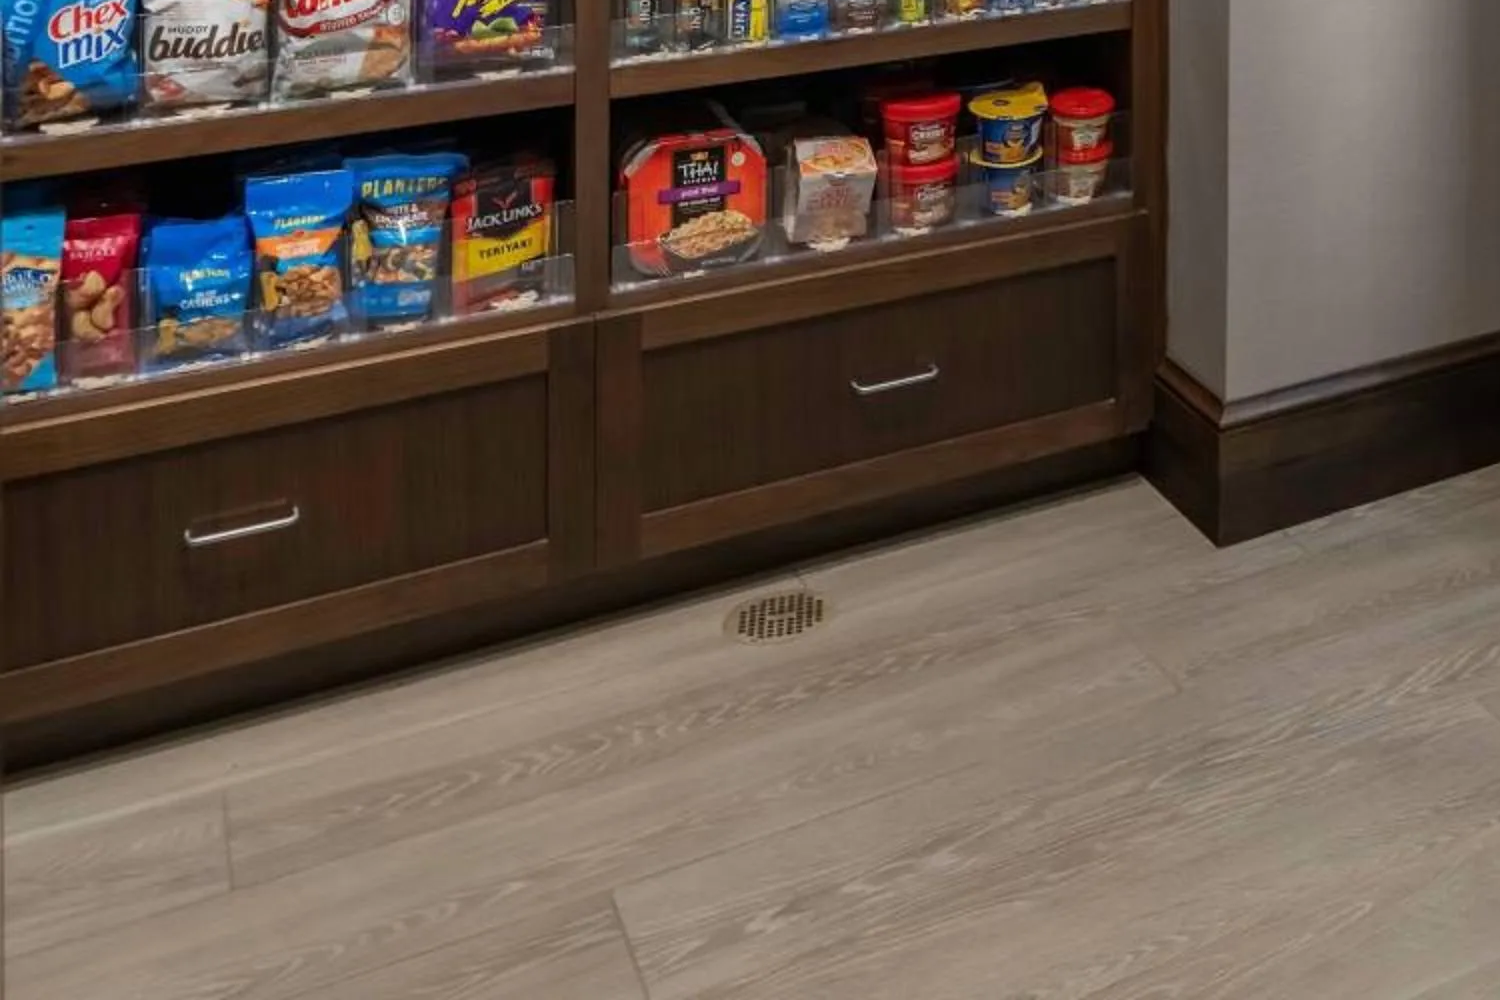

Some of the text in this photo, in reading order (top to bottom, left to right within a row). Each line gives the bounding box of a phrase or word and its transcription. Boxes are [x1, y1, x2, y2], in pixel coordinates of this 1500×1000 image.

[59, 24, 126, 69] mix
[678, 163, 720, 180] THAI
[360, 177, 450, 198] PLANTERS
[466, 203, 543, 232] JACK LINK'S
[479, 239, 533, 261] TERIYAKI
